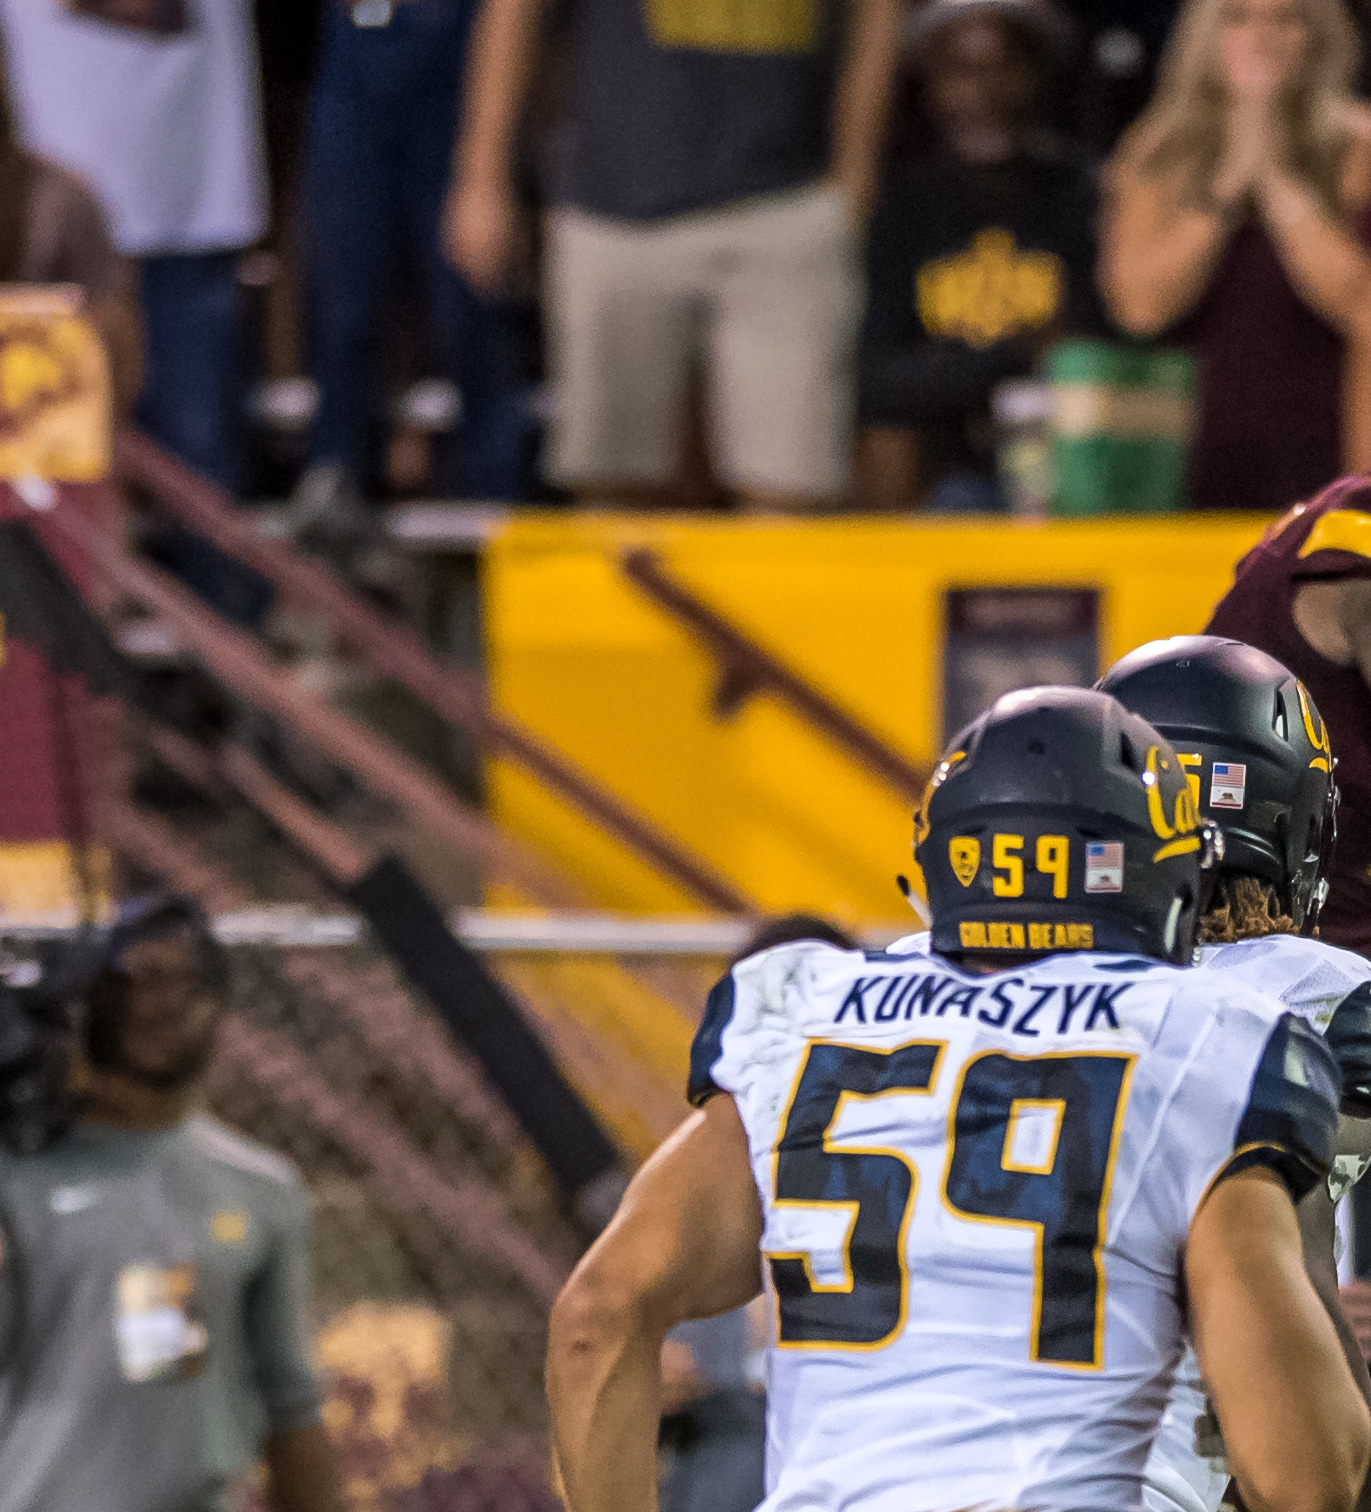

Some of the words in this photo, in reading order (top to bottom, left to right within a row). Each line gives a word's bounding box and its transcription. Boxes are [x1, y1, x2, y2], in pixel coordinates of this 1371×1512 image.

[992, 833, 1070, 899] 59
[833, 973, 1136, 1038] KUNASZYK
[762, 1036, 1141, 1370] 59
